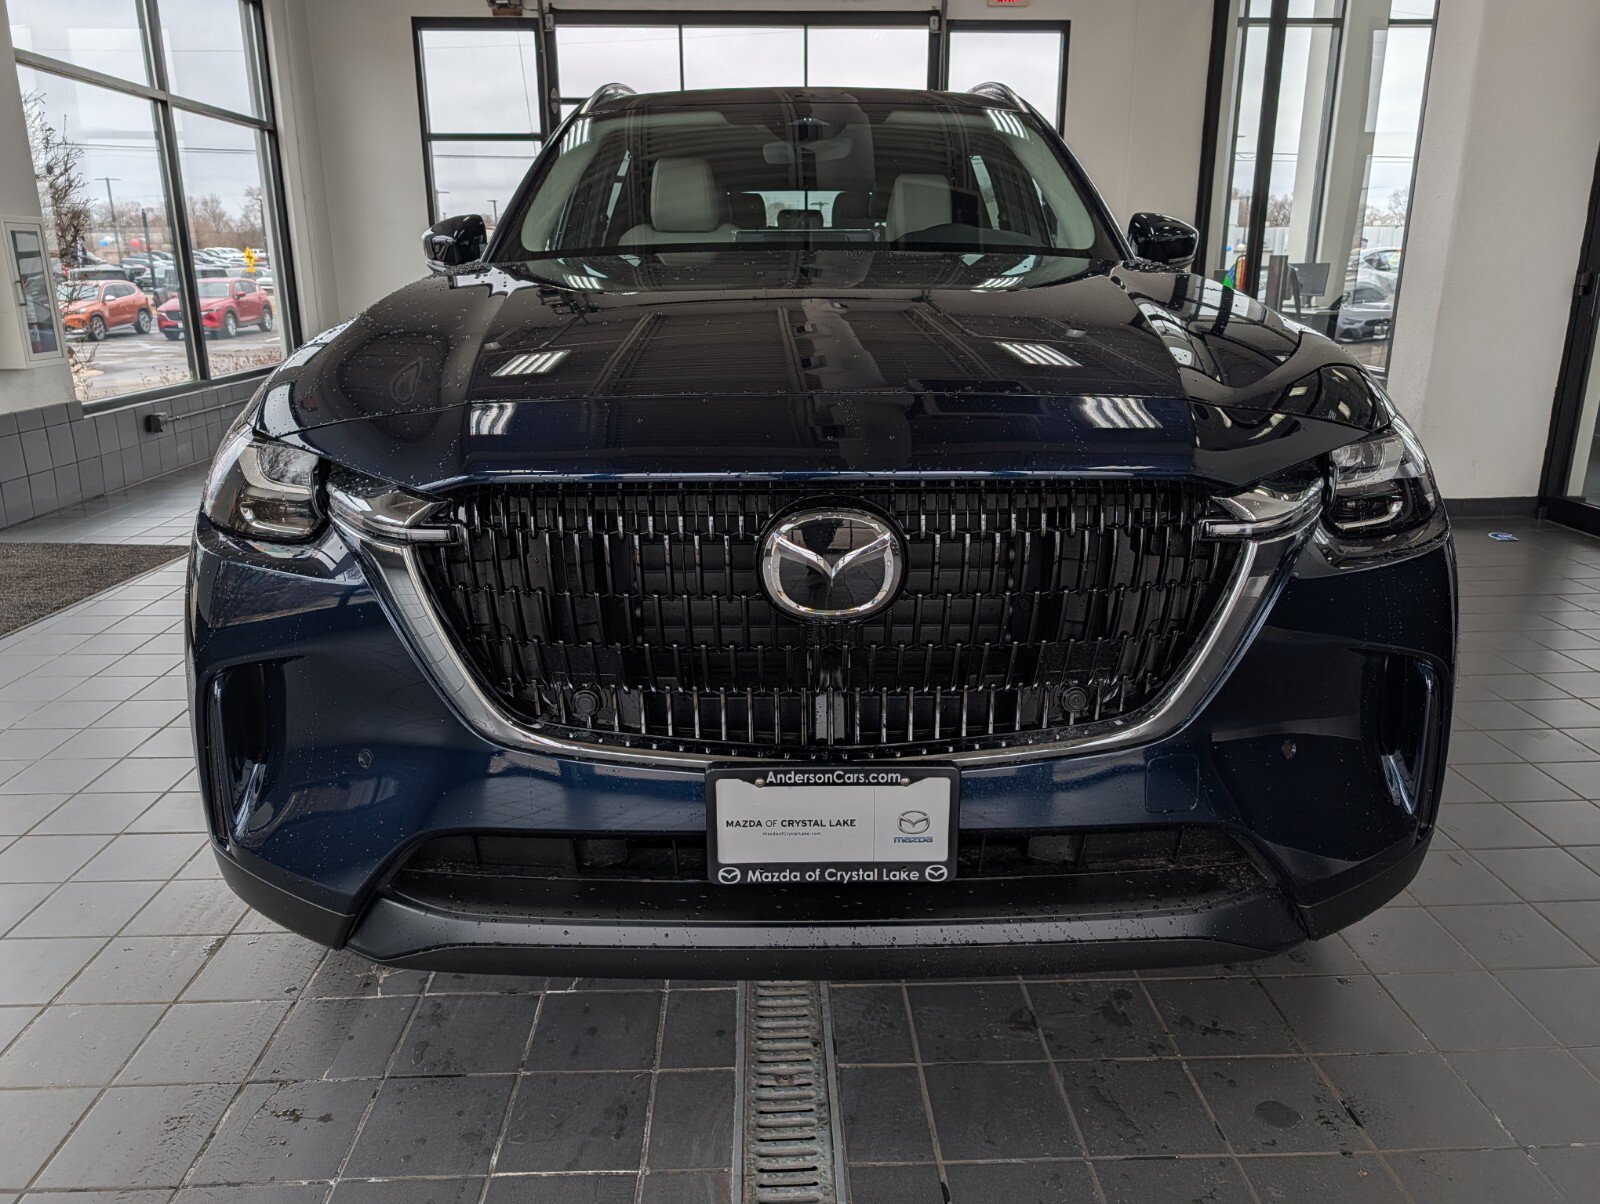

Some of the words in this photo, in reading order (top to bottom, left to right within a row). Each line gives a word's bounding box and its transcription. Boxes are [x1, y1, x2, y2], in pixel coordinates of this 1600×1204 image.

[766, 771, 901, 784] AndersonCars.com
[725, 819, 763, 828] MAZDA
[765, 819, 778, 828] OF
[780, 819, 827, 828] CRYSTAL
[829, 818, 857, 828] LAKE
[893, 836, 934, 844] mazda
[747, 868, 800, 882] Mazda
[805, 868, 821, 882] of
[824, 867, 878, 884] Crystal
[882, 868, 920, 881] Lake
